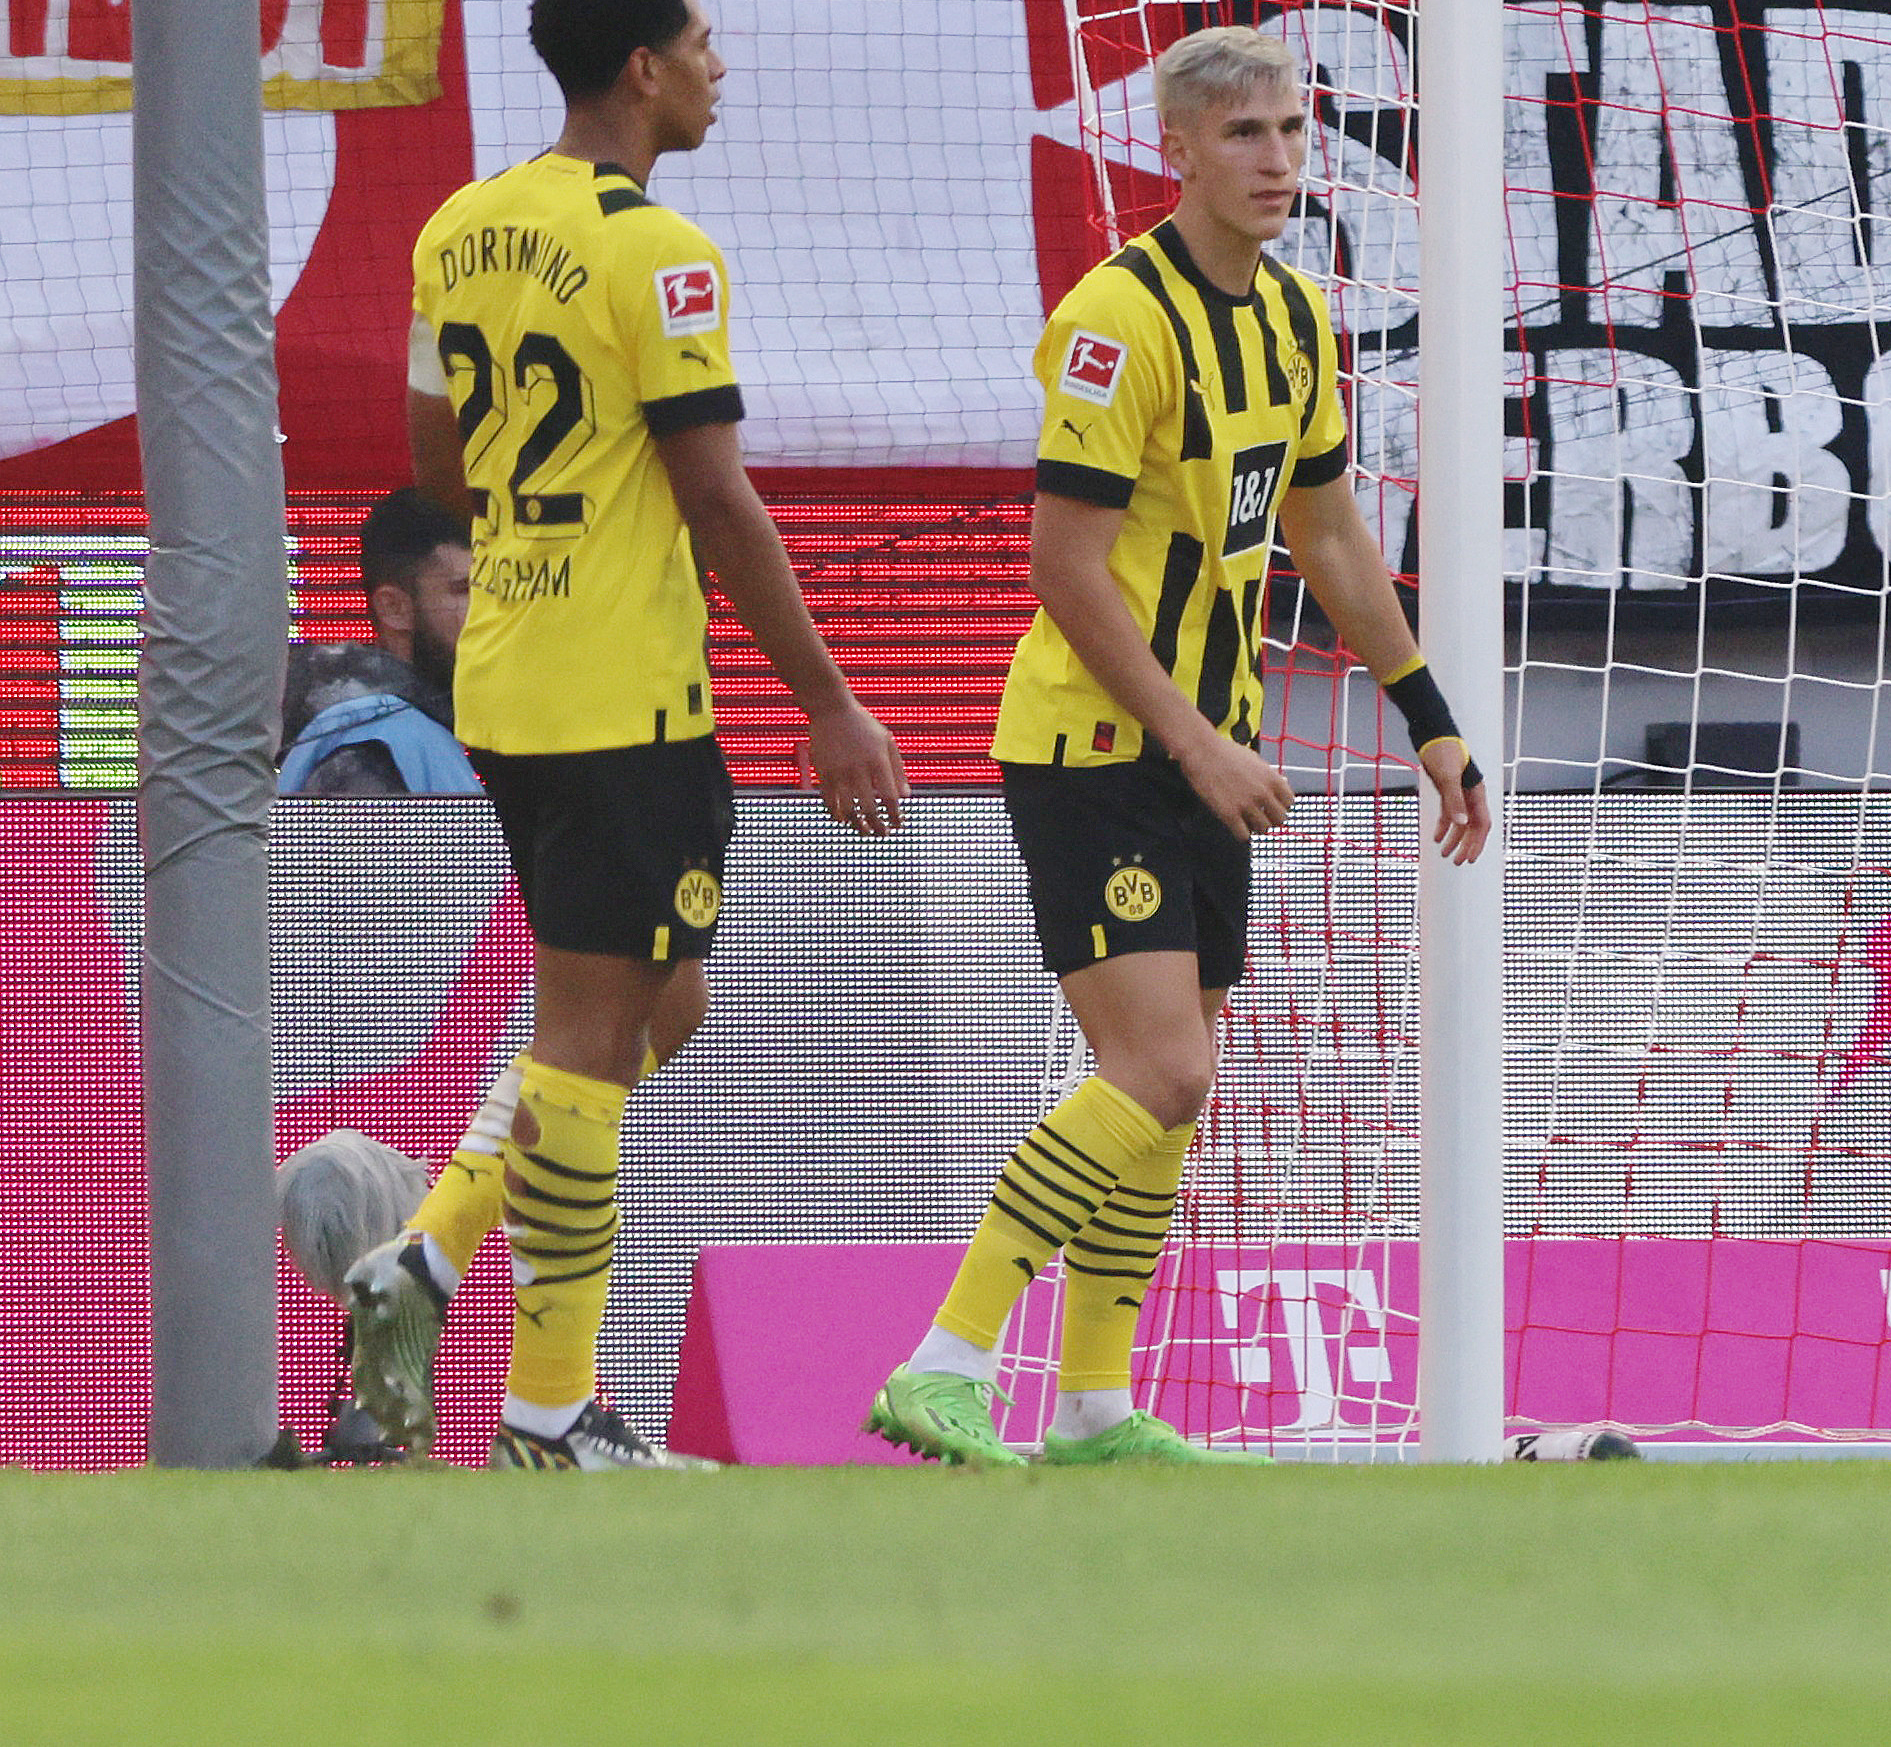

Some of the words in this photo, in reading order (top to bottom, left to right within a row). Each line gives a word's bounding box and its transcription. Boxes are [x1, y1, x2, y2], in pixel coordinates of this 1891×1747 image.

[438, 321, 597, 538] 22
[1231, 466, 1276, 526] 1&1
[681, 876, 714, 910] BVB
[1114, 873, 1155, 907] BVB
[1216, 1269, 1392, 1430] T
